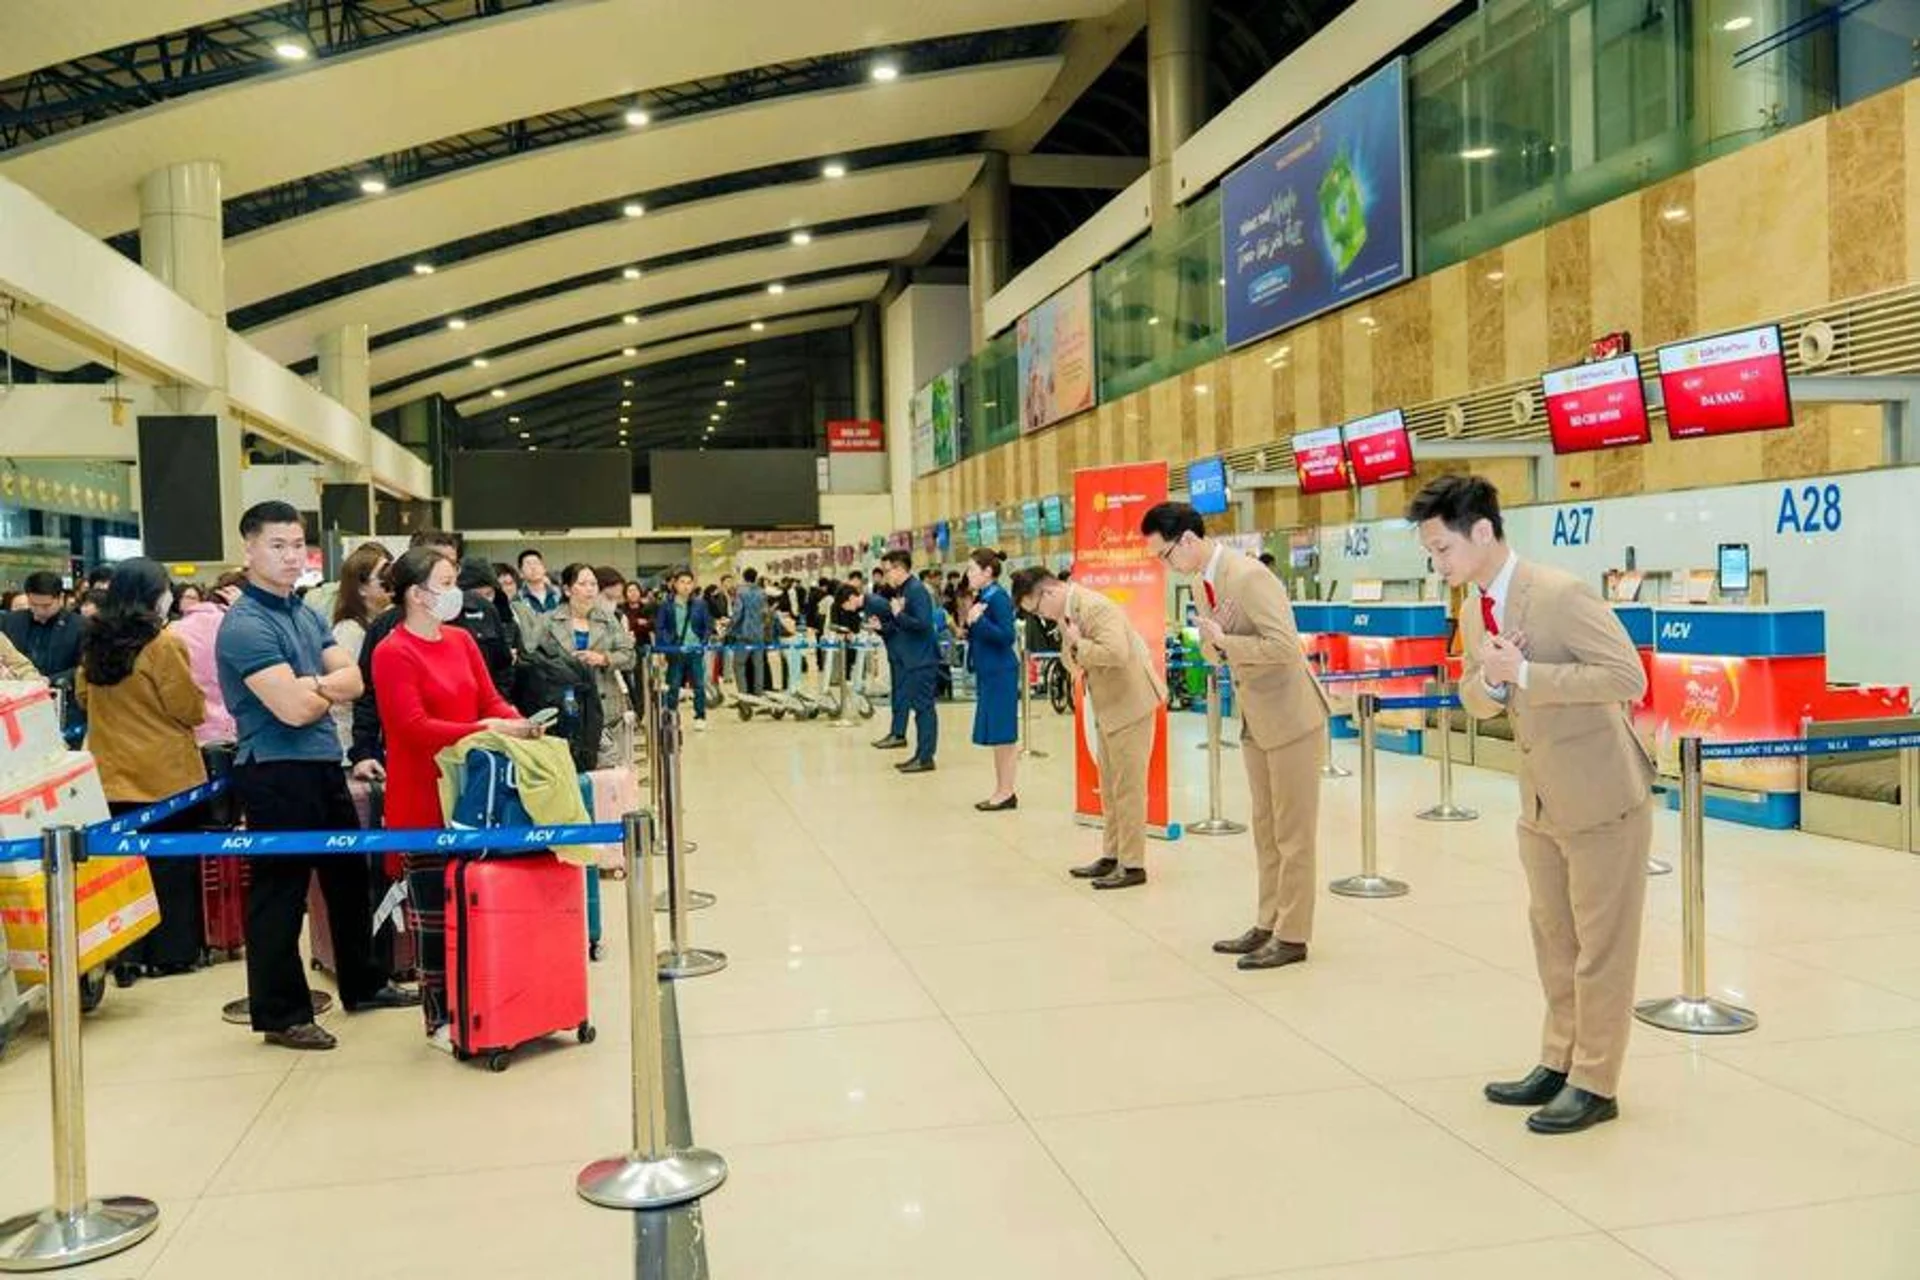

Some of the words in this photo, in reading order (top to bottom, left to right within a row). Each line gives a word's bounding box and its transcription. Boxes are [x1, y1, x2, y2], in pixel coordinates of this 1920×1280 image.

[1776, 483, 1843, 535] A28
[1552, 506, 1595, 547] A27
[1343, 528, 1371, 557] A25
[1660, 621, 1693, 640] ACV
[221, 837, 252, 850] ACV
[326, 835, 357, 848] ACV
[524, 829, 555, 843] ACV
